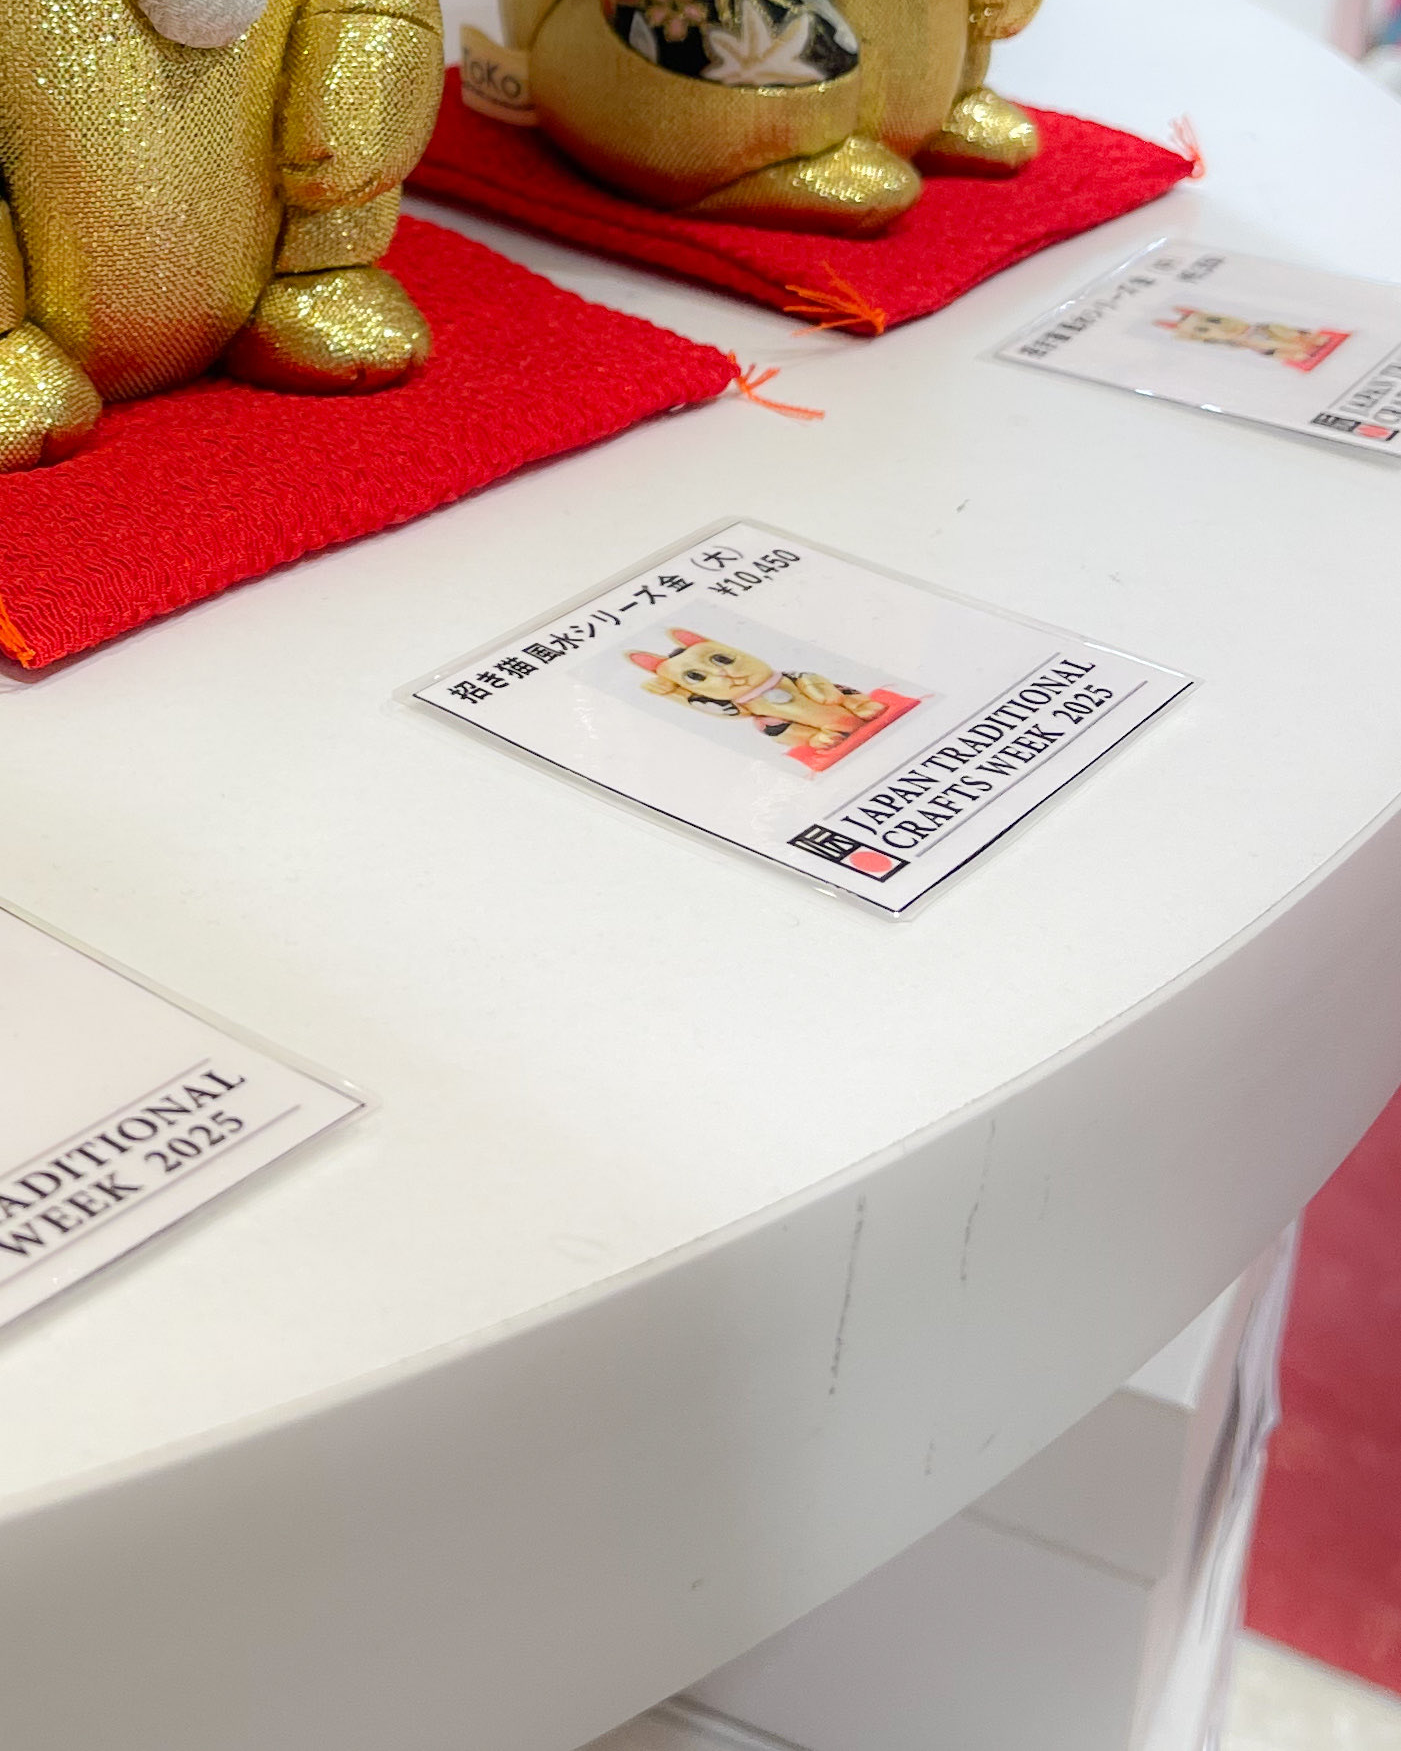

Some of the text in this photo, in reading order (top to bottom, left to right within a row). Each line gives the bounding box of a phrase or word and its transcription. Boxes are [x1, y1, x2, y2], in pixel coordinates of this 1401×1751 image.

[708, 549, 801, 597] ¥10,450
[841, 658, 1096, 836] JAPAN TRADITIONAL
[881, 683, 1115, 850] CRAFTS WEEK 2025
[144, 1110, 245, 1173] 2025
